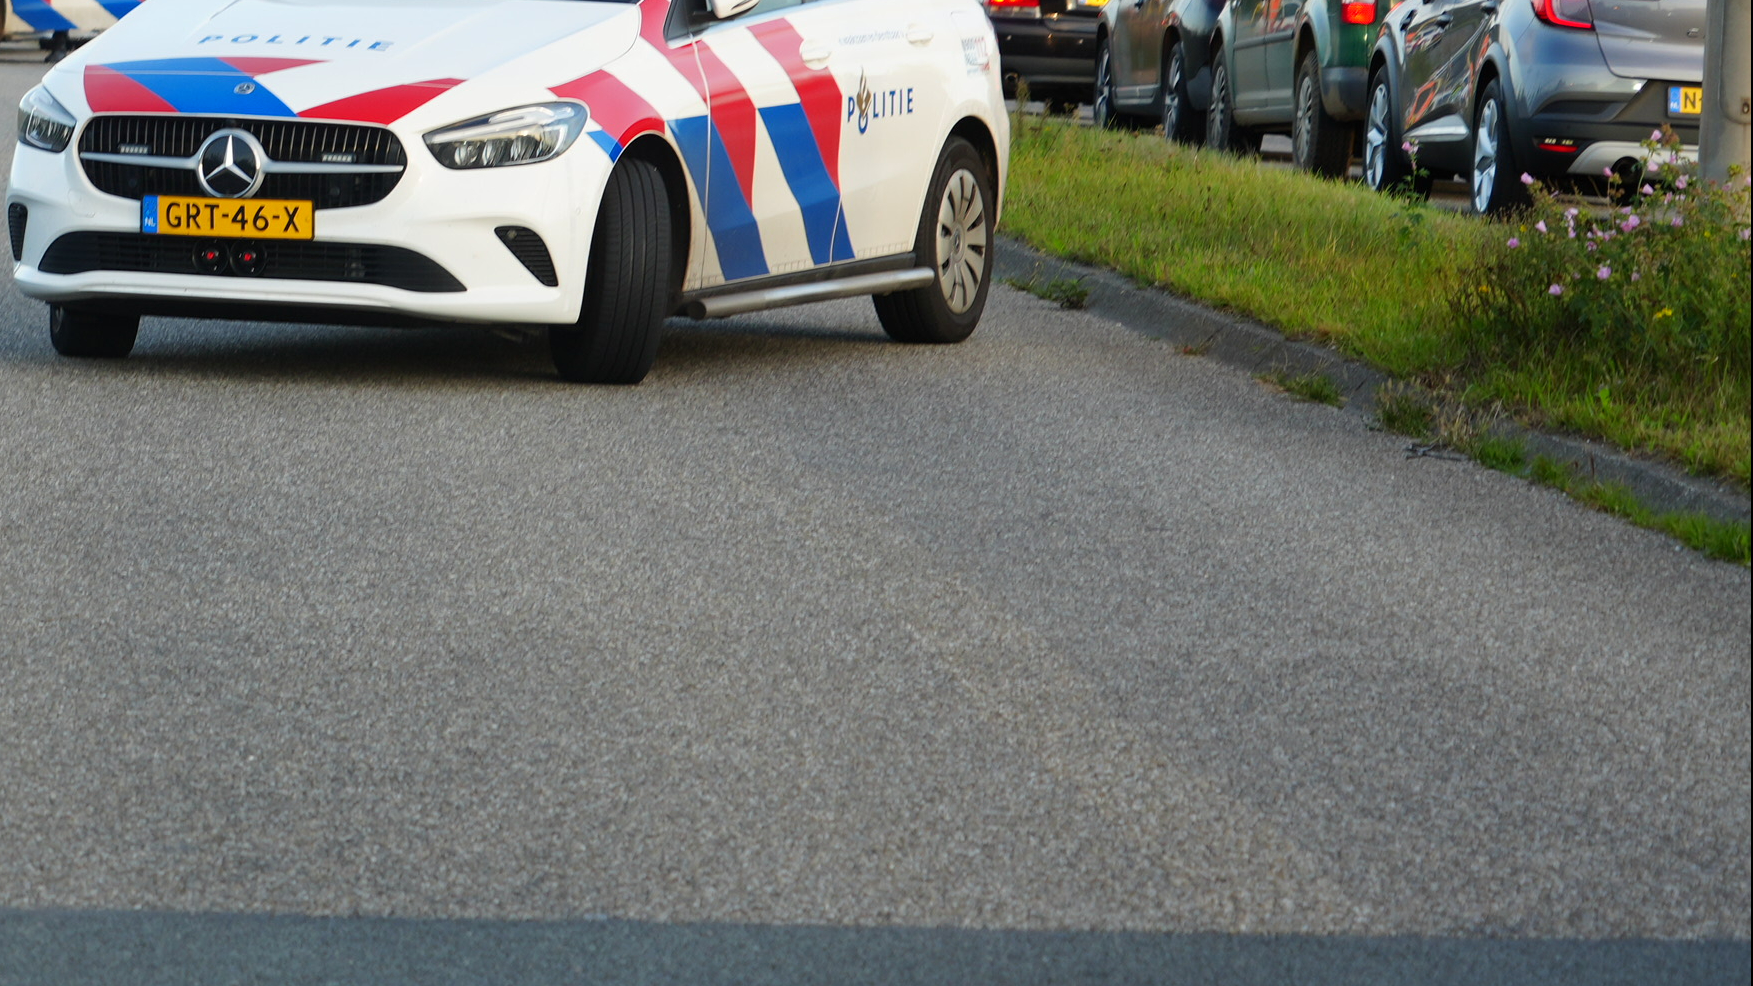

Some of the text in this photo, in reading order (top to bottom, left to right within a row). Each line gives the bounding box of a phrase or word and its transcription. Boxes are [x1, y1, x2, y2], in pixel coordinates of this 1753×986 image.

[197, 34, 394, 52] POLITIE
[144, 216, 156, 227] NL
[165, 202, 300, 233] GRT-46-X
